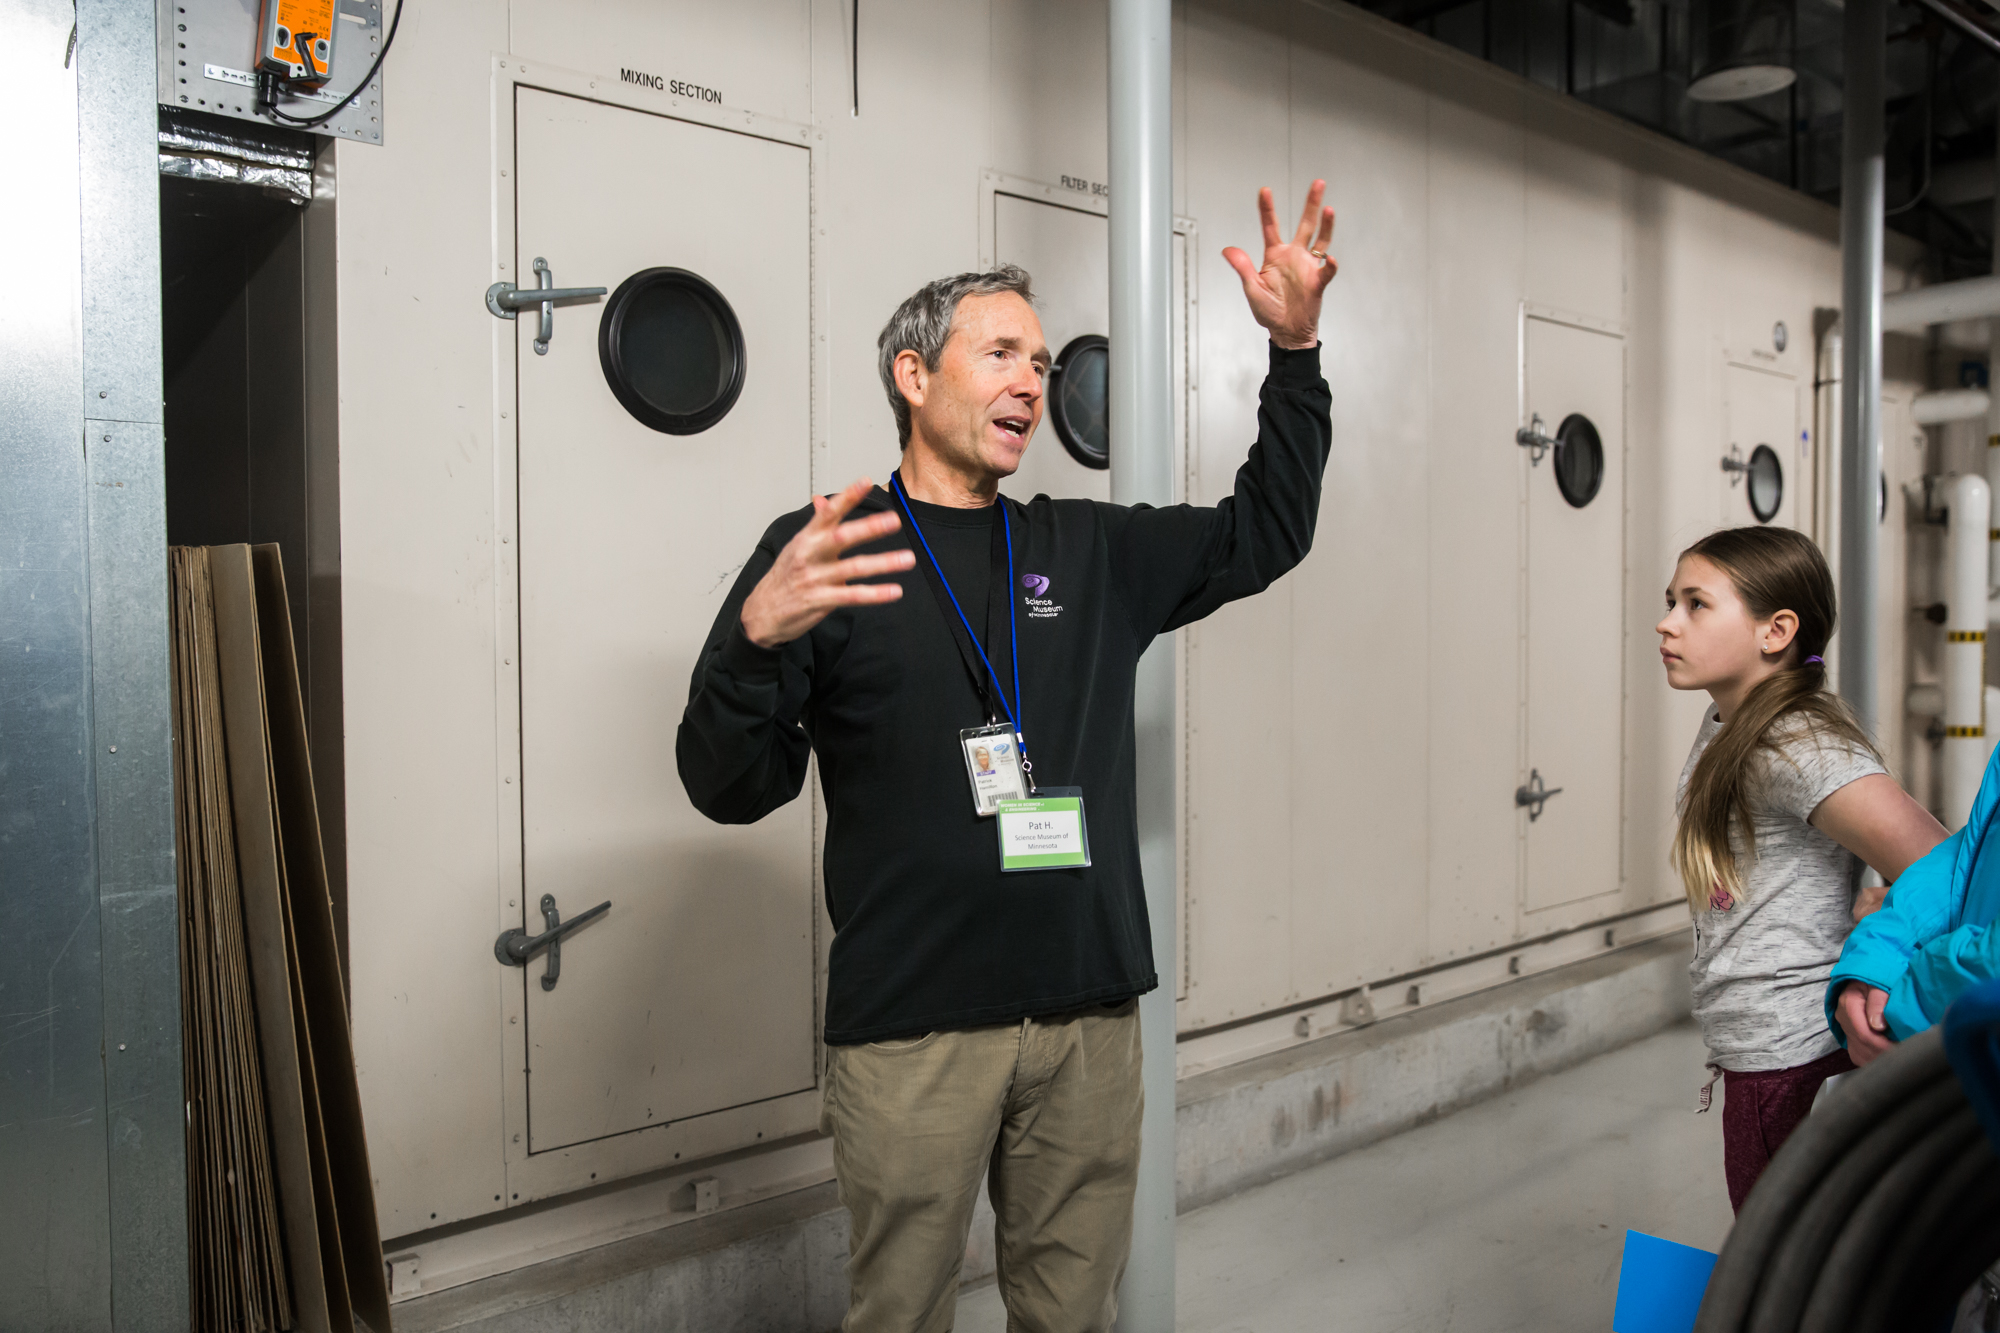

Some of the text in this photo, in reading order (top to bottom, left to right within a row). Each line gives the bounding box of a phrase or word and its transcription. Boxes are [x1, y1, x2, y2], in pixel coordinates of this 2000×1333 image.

[621, 67, 722, 105] MIXING SECTION
[1061, 175, 1088, 191] FILTER
[1024, 597, 1053, 606] Science
[1033, 605, 1064, 613] Museum
[1028, 821, 1054, 830] Pat H.
